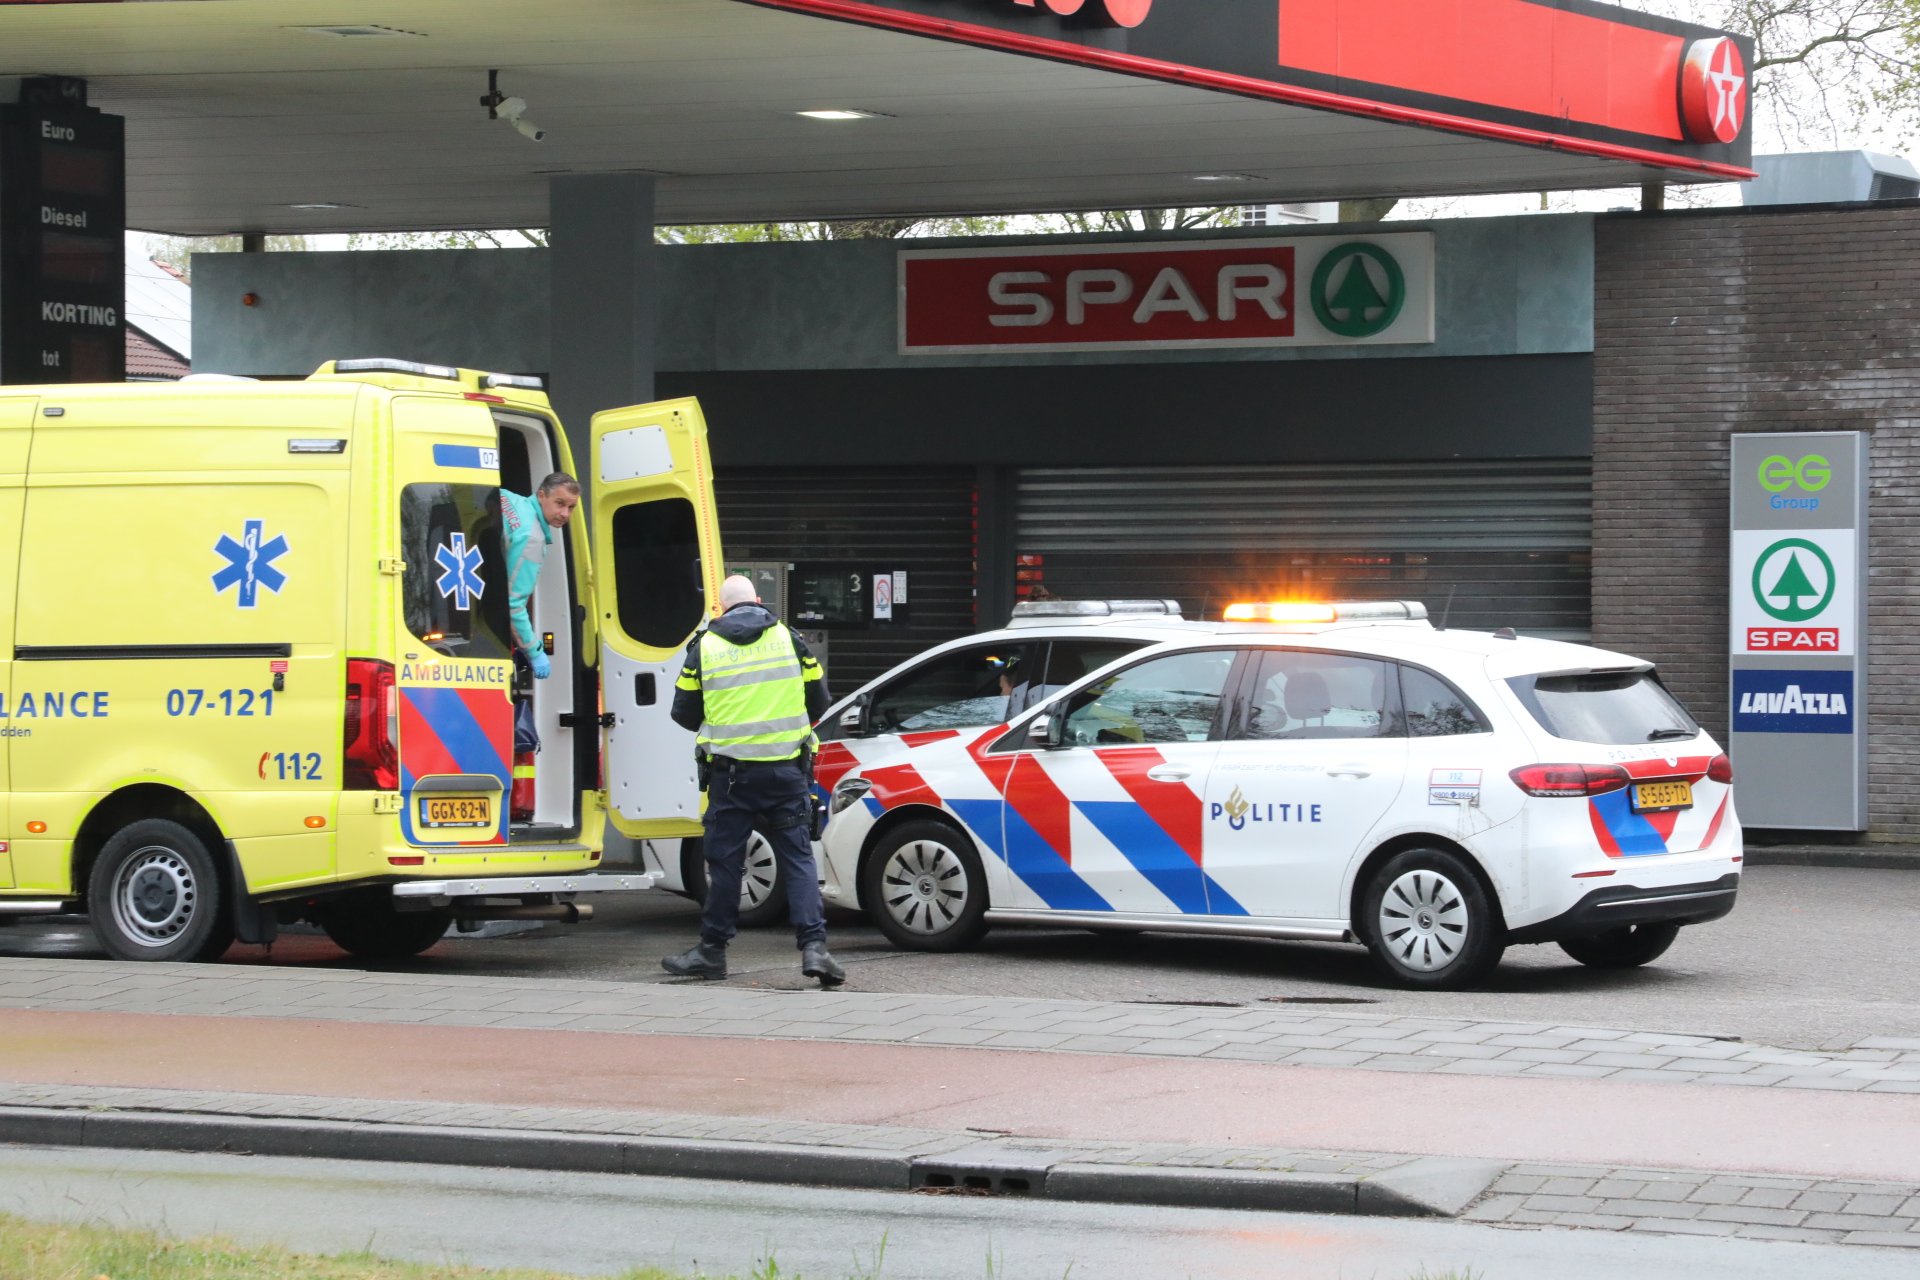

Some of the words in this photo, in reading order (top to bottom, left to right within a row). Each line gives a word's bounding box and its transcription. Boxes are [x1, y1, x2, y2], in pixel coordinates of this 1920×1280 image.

[41, 120, 75, 141] Euro
[41, 206, 87, 228] Diesel
[987, 263, 1287, 327] SPAR
[42, 301, 117, 327] KORTING
[42, 349, 60, 367] tot
[1769, 494, 1820, 512] Group
[850, 573, 862, 593] 3
[1750, 631, 1837, 647] SPAR
[719, 643, 777, 662] POLITIE
[401, 663, 505, 683] AMBULANCE
[167, 688, 274, 717] 07-121
[1739, 685, 1848, 715] LAVAZZA
[1608, 747, 1660, 762] POLITIE
[1640, 784, 1688, 805] S-565-TD
[431, 801, 487, 820] GGX-82-N
[1211, 802, 1322, 831] POLITIE
